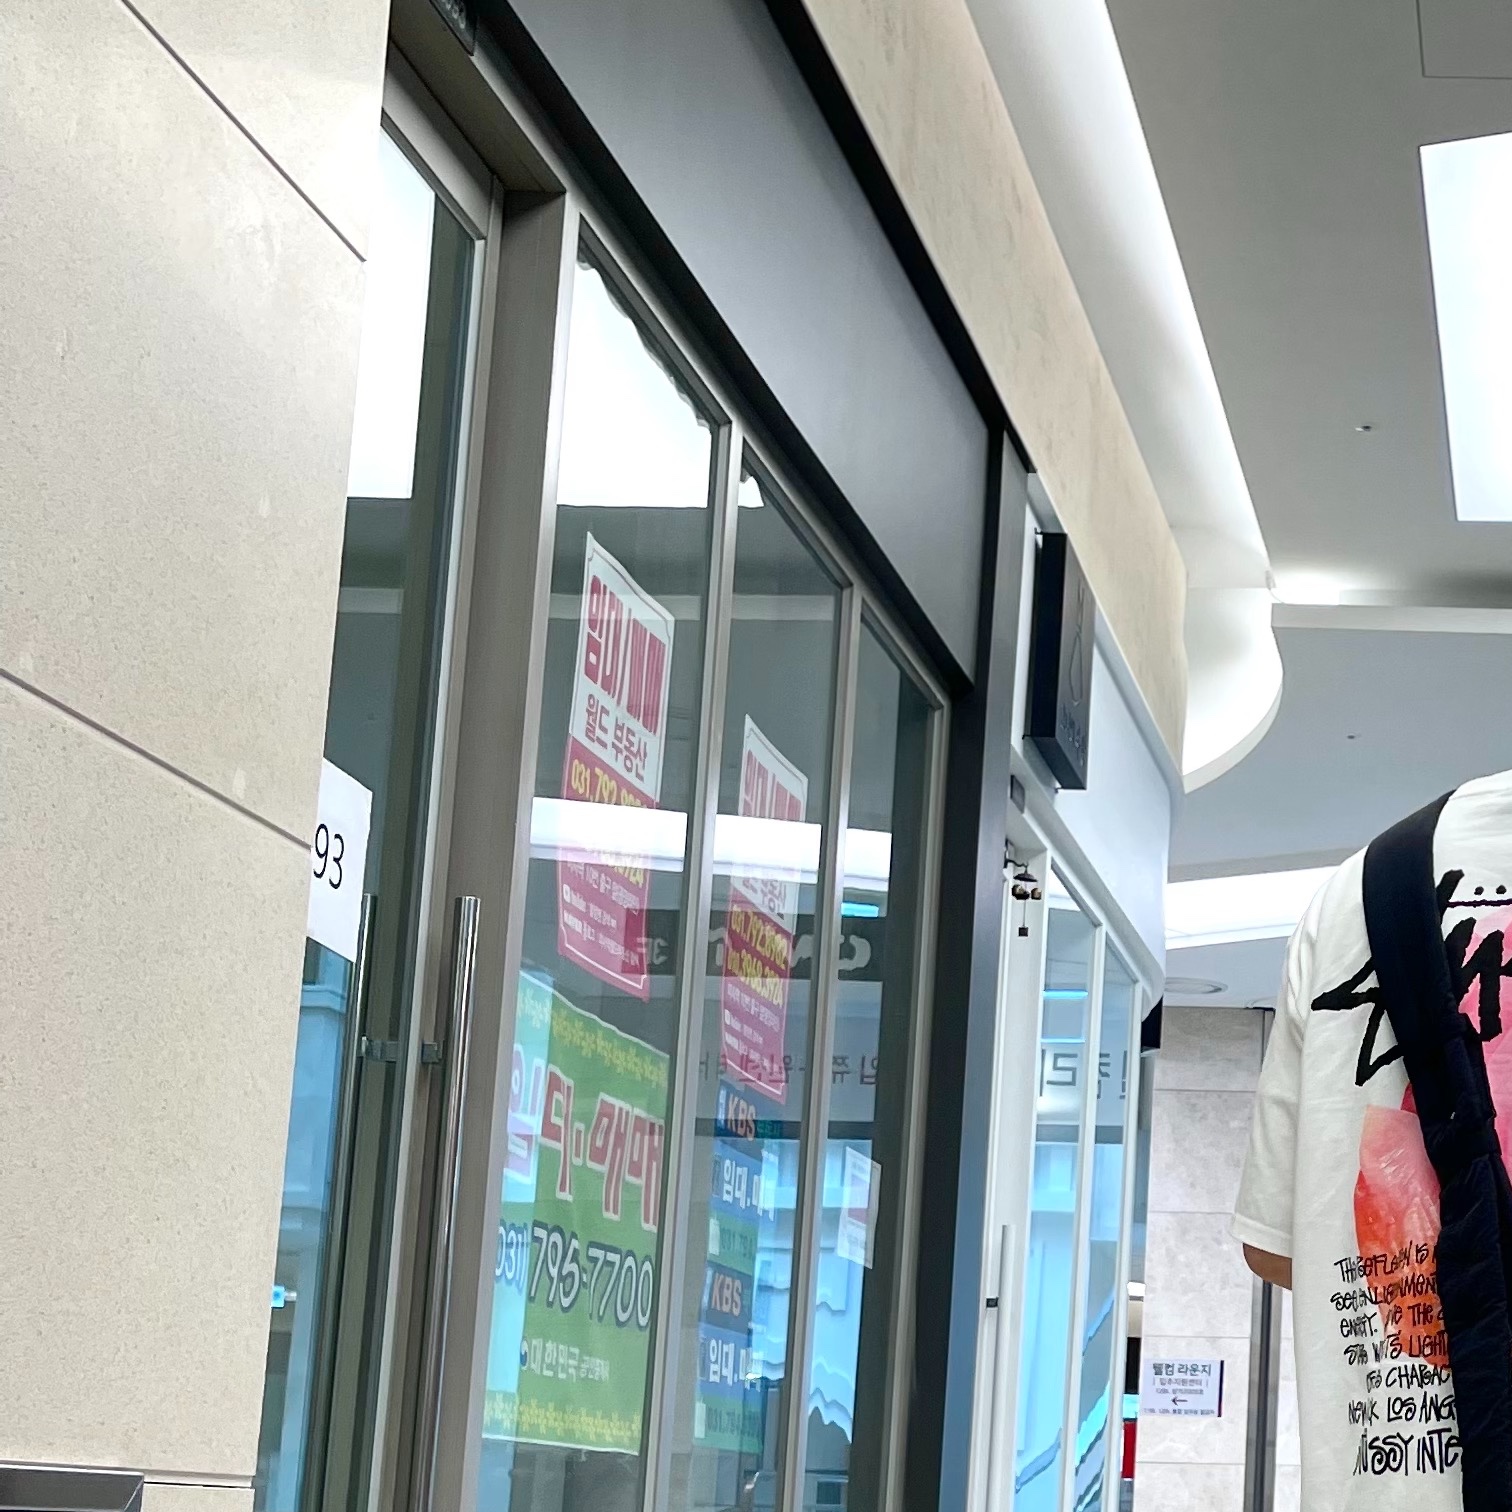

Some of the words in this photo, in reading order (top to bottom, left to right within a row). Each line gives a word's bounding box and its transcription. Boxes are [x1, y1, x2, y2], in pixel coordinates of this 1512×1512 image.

[584, 693, 609, 750] 월드
[612, 715, 647, 783] 부동산
[313, 823, 345, 890] 93
[727, 1090, 756, 1141] KBS
[530, 1220, 655, 1328] 795-7700
[711, 1272, 742, 1317] KBS
[531, 1338, 580, 1382] 대한민국
[1177, 1363, 1211, 1377] 라운지
[1387, 1396, 1416, 1422] LOS
